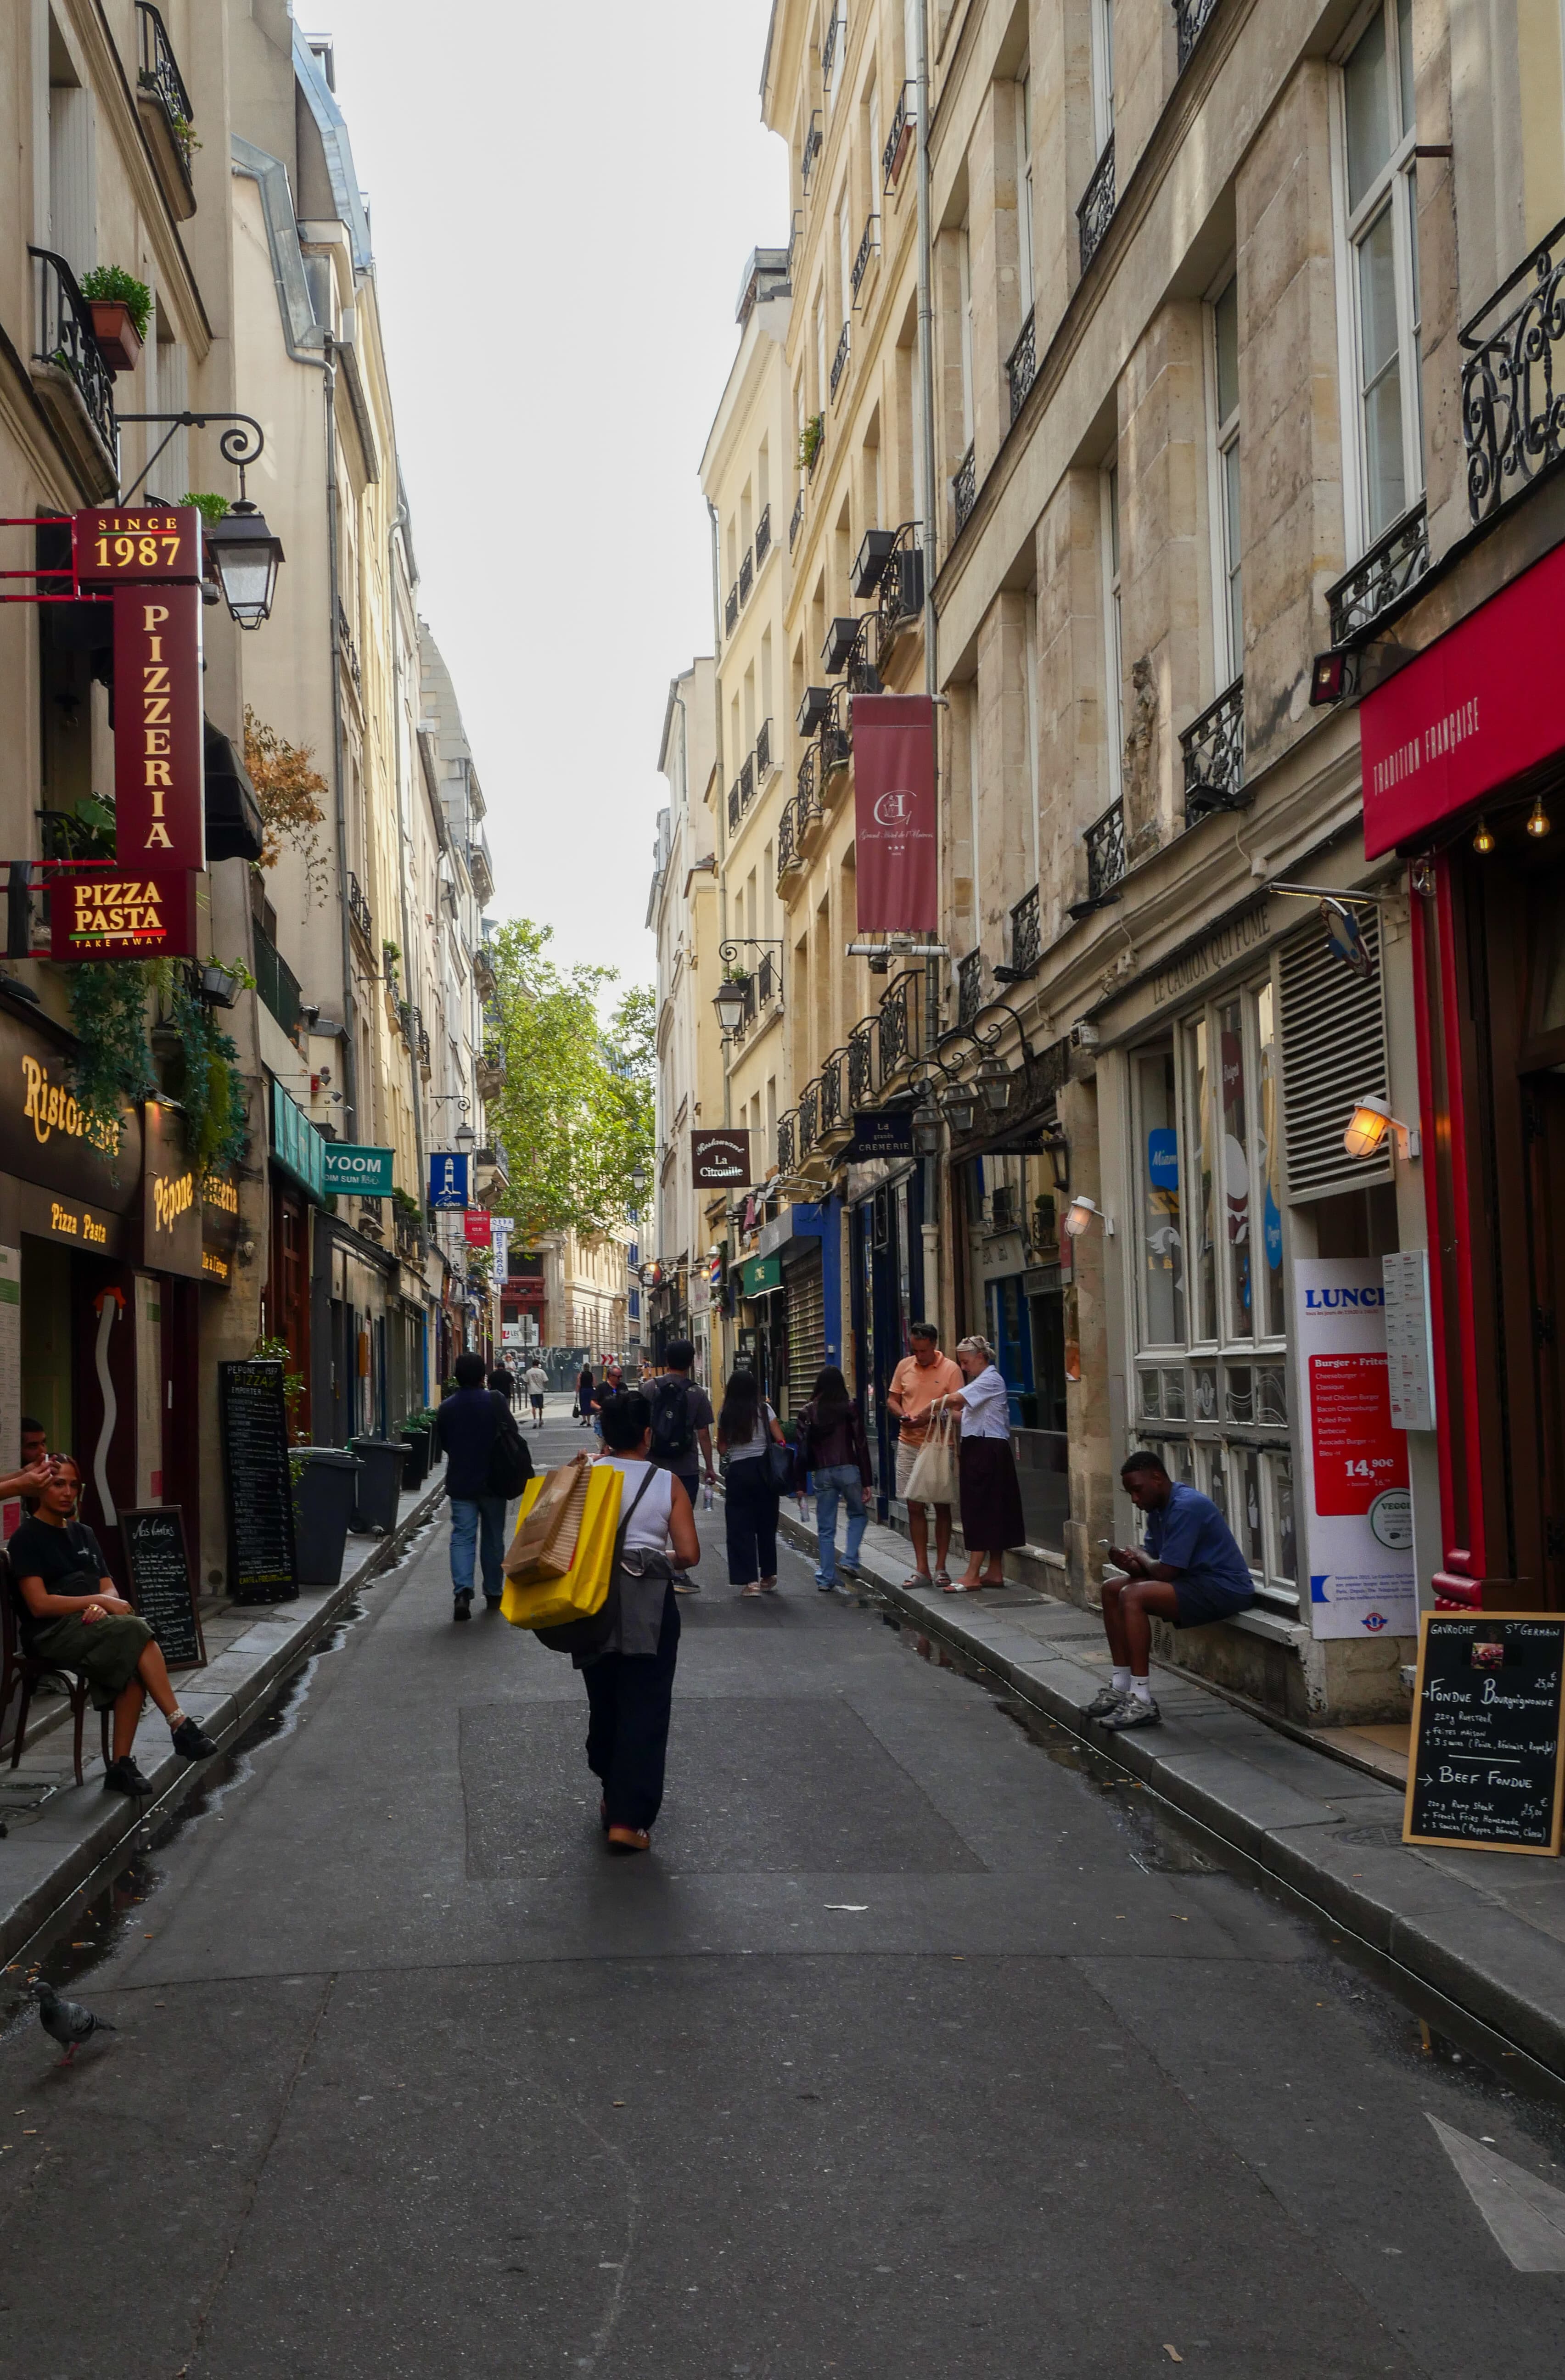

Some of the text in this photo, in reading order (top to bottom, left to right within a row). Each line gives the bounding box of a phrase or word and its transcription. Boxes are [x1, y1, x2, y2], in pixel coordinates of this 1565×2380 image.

[98, 518, 178, 531] SINCE
[95, 536, 181, 567] 1987
[142, 605, 174, 849] PIZZERIA
[1374, 737, 1420, 796] TRADITION
[74, 881, 163, 907] PIZZA
[74, 907, 162, 932] PASTA
[75, 936, 163, 949] TAKE AWAY
[1153, 904, 1270, 1005] LE CAMION QUI FUME
[696, 1138, 745, 1156] Restaurant
[325, 1155, 381, 1173] YOOM
[714, 1155, 728, 1165] La
[341, 1175, 359, 1184] SUM
[700, 1166, 743, 1178] Citrouille
[154, 1172, 193, 1233] Pépone
[51, 1202, 107, 1243] Pizza Pasta
[1315, 1359, 1350, 1368] Burger
[1359, 1358, 1388, 1366] Frites
[1430, 1624, 1477, 1634] GAVROCHE
[1430, 1678, 1472, 1702] FONDUE
[1439, 1766, 1532, 1788] BEEF FONDUE
[1451, 1799, 1470, 1811] Rump
[1432, 1812, 1456, 1820] French
[1459, 1812, 1479, 1823] Fries
